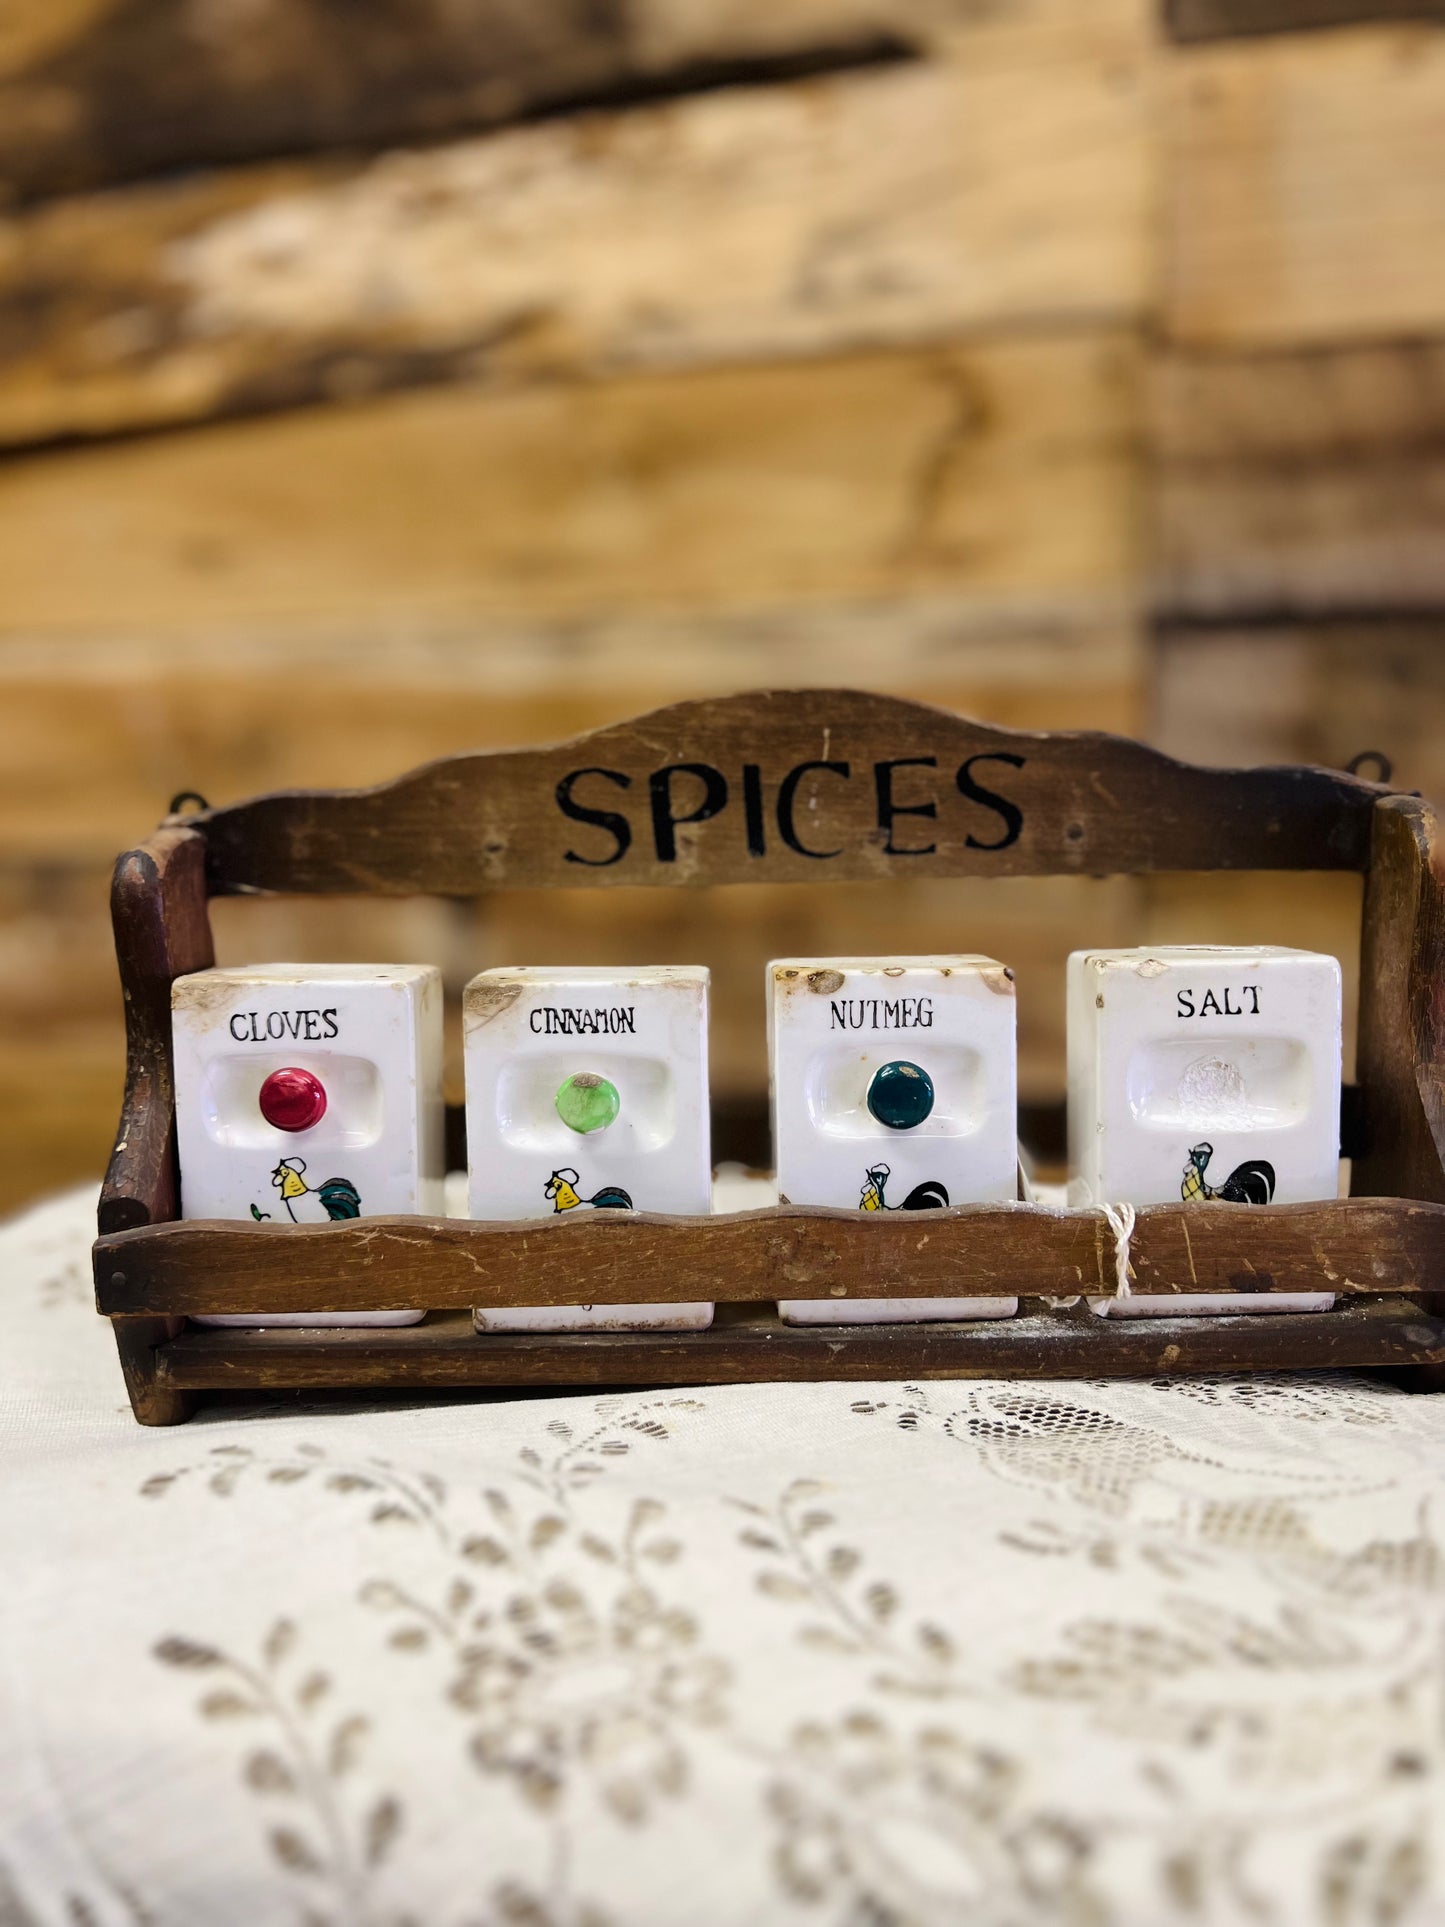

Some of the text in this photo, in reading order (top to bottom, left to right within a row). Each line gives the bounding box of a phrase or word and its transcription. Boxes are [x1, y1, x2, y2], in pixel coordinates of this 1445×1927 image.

[555, 752, 1027, 866] SPICES
[830, 998, 934, 1029] NUTMEG
[1177, 985, 1261, 1018] SALT
[230, 1008, 338, 1041] CLOVES
[529, 1006, 636, 1035] CINNAMON
